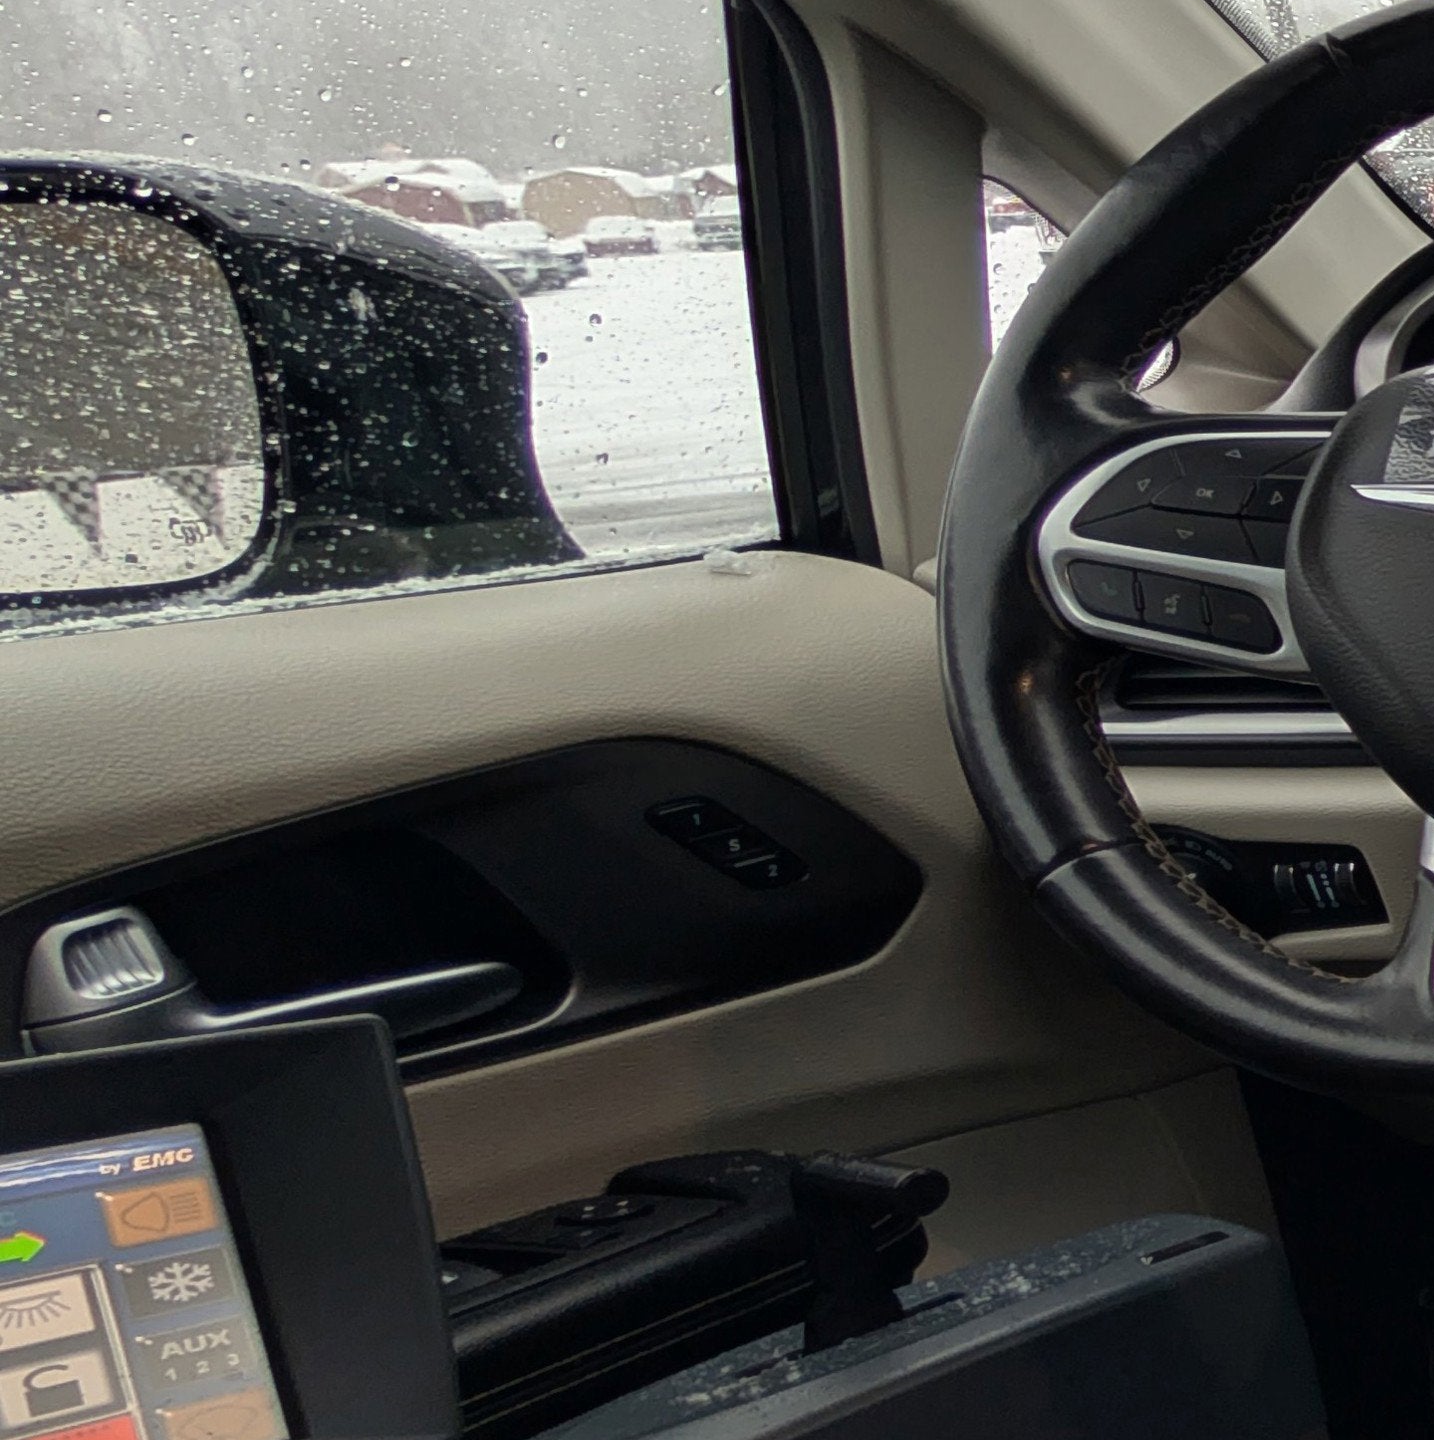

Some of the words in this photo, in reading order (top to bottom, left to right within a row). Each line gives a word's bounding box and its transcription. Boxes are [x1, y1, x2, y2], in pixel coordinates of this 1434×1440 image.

[1196, 487, 1214, 499] OK
[693, 813, 700, 825] 1
[728, 839, 741, 851] S
[768, 864, 778, 876] 2
[99, 1163, 120, 1175] by
[133, 1148, 194, 1171] EMC
[161, 1329, 231, 1360] AUX
[165, 1368, 177, 1381] 1
[196, 1361, 210, 1374] 2
[227, 1353, 240, 1366] 3
